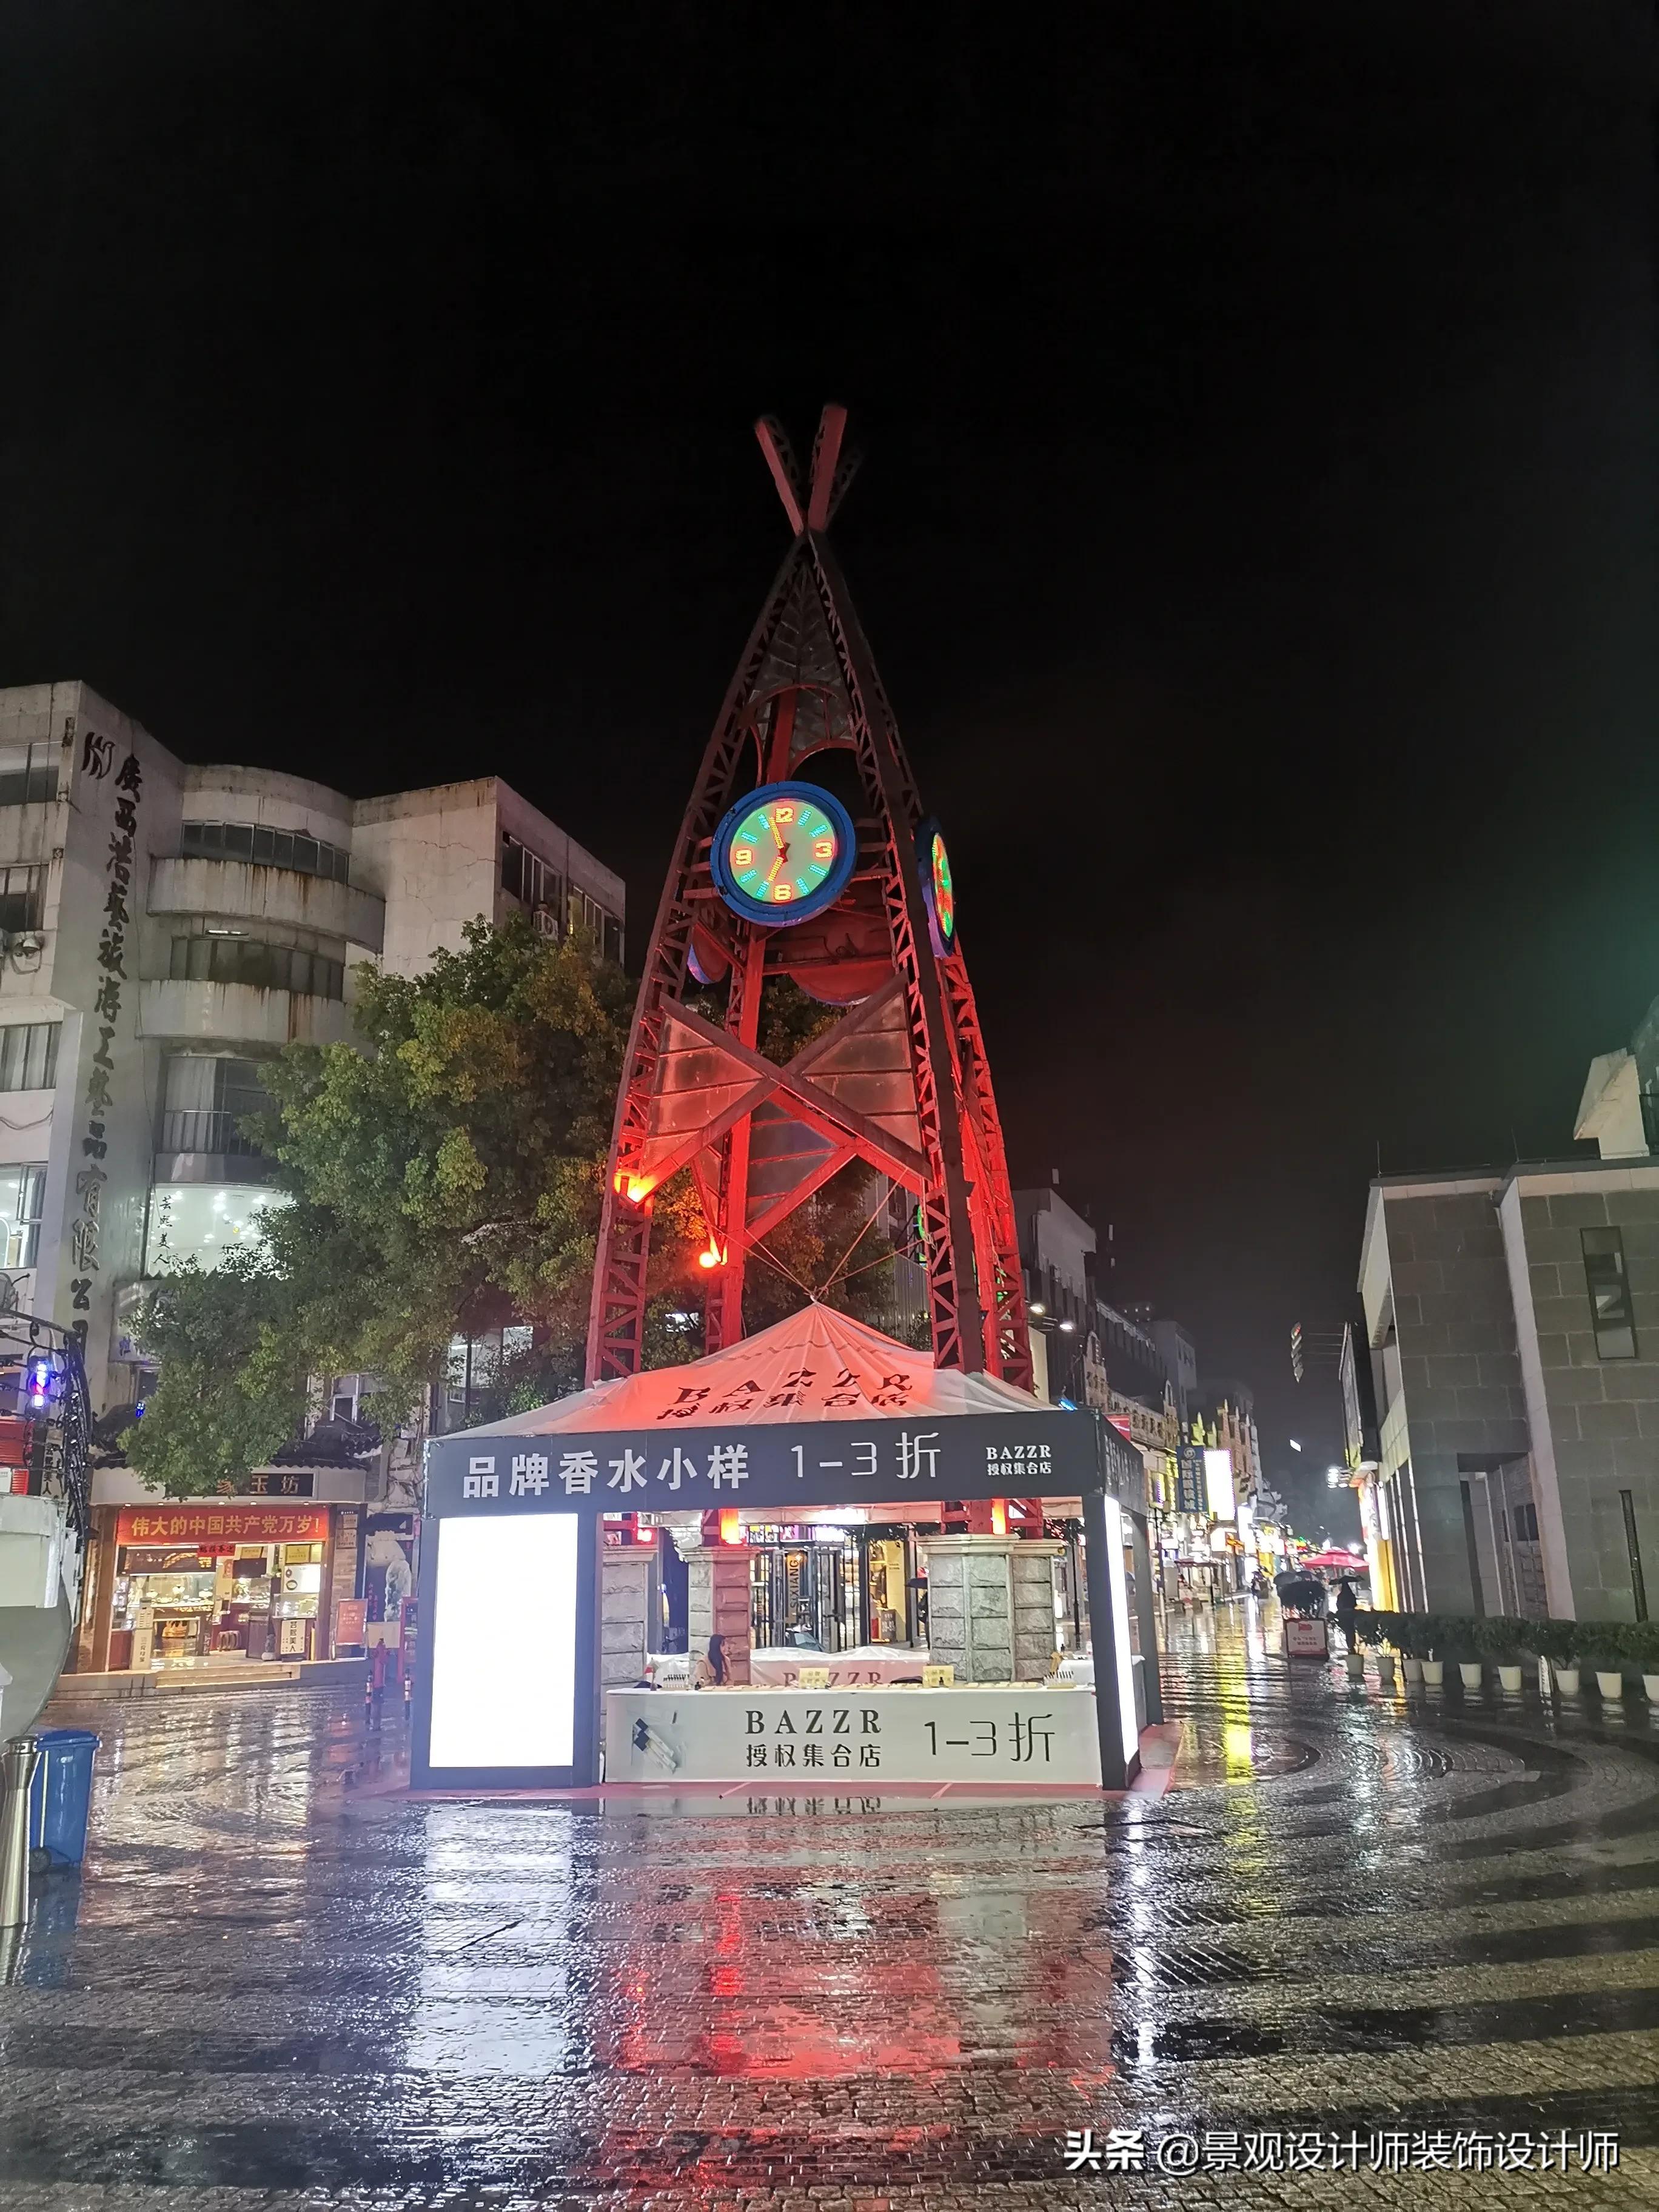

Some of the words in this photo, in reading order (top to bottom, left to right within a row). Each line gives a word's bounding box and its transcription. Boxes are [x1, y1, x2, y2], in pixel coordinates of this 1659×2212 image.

[735, 849, 752, 866] 9
[815, 842, 833, 859] 3
[773, 883, 792, 901] 6
[669, 1367, 913, 1405] BAZZR
[985, 1444, 1052, 1461] BAZZR
[463, 1444, 749, 1498] 品牌香水小样
[987, 1461, 1052, 1476] 授权集合店
[745, 1709, 882, 1734] BAZZR
[745, 1743, 881, 1768] 授权集合店
